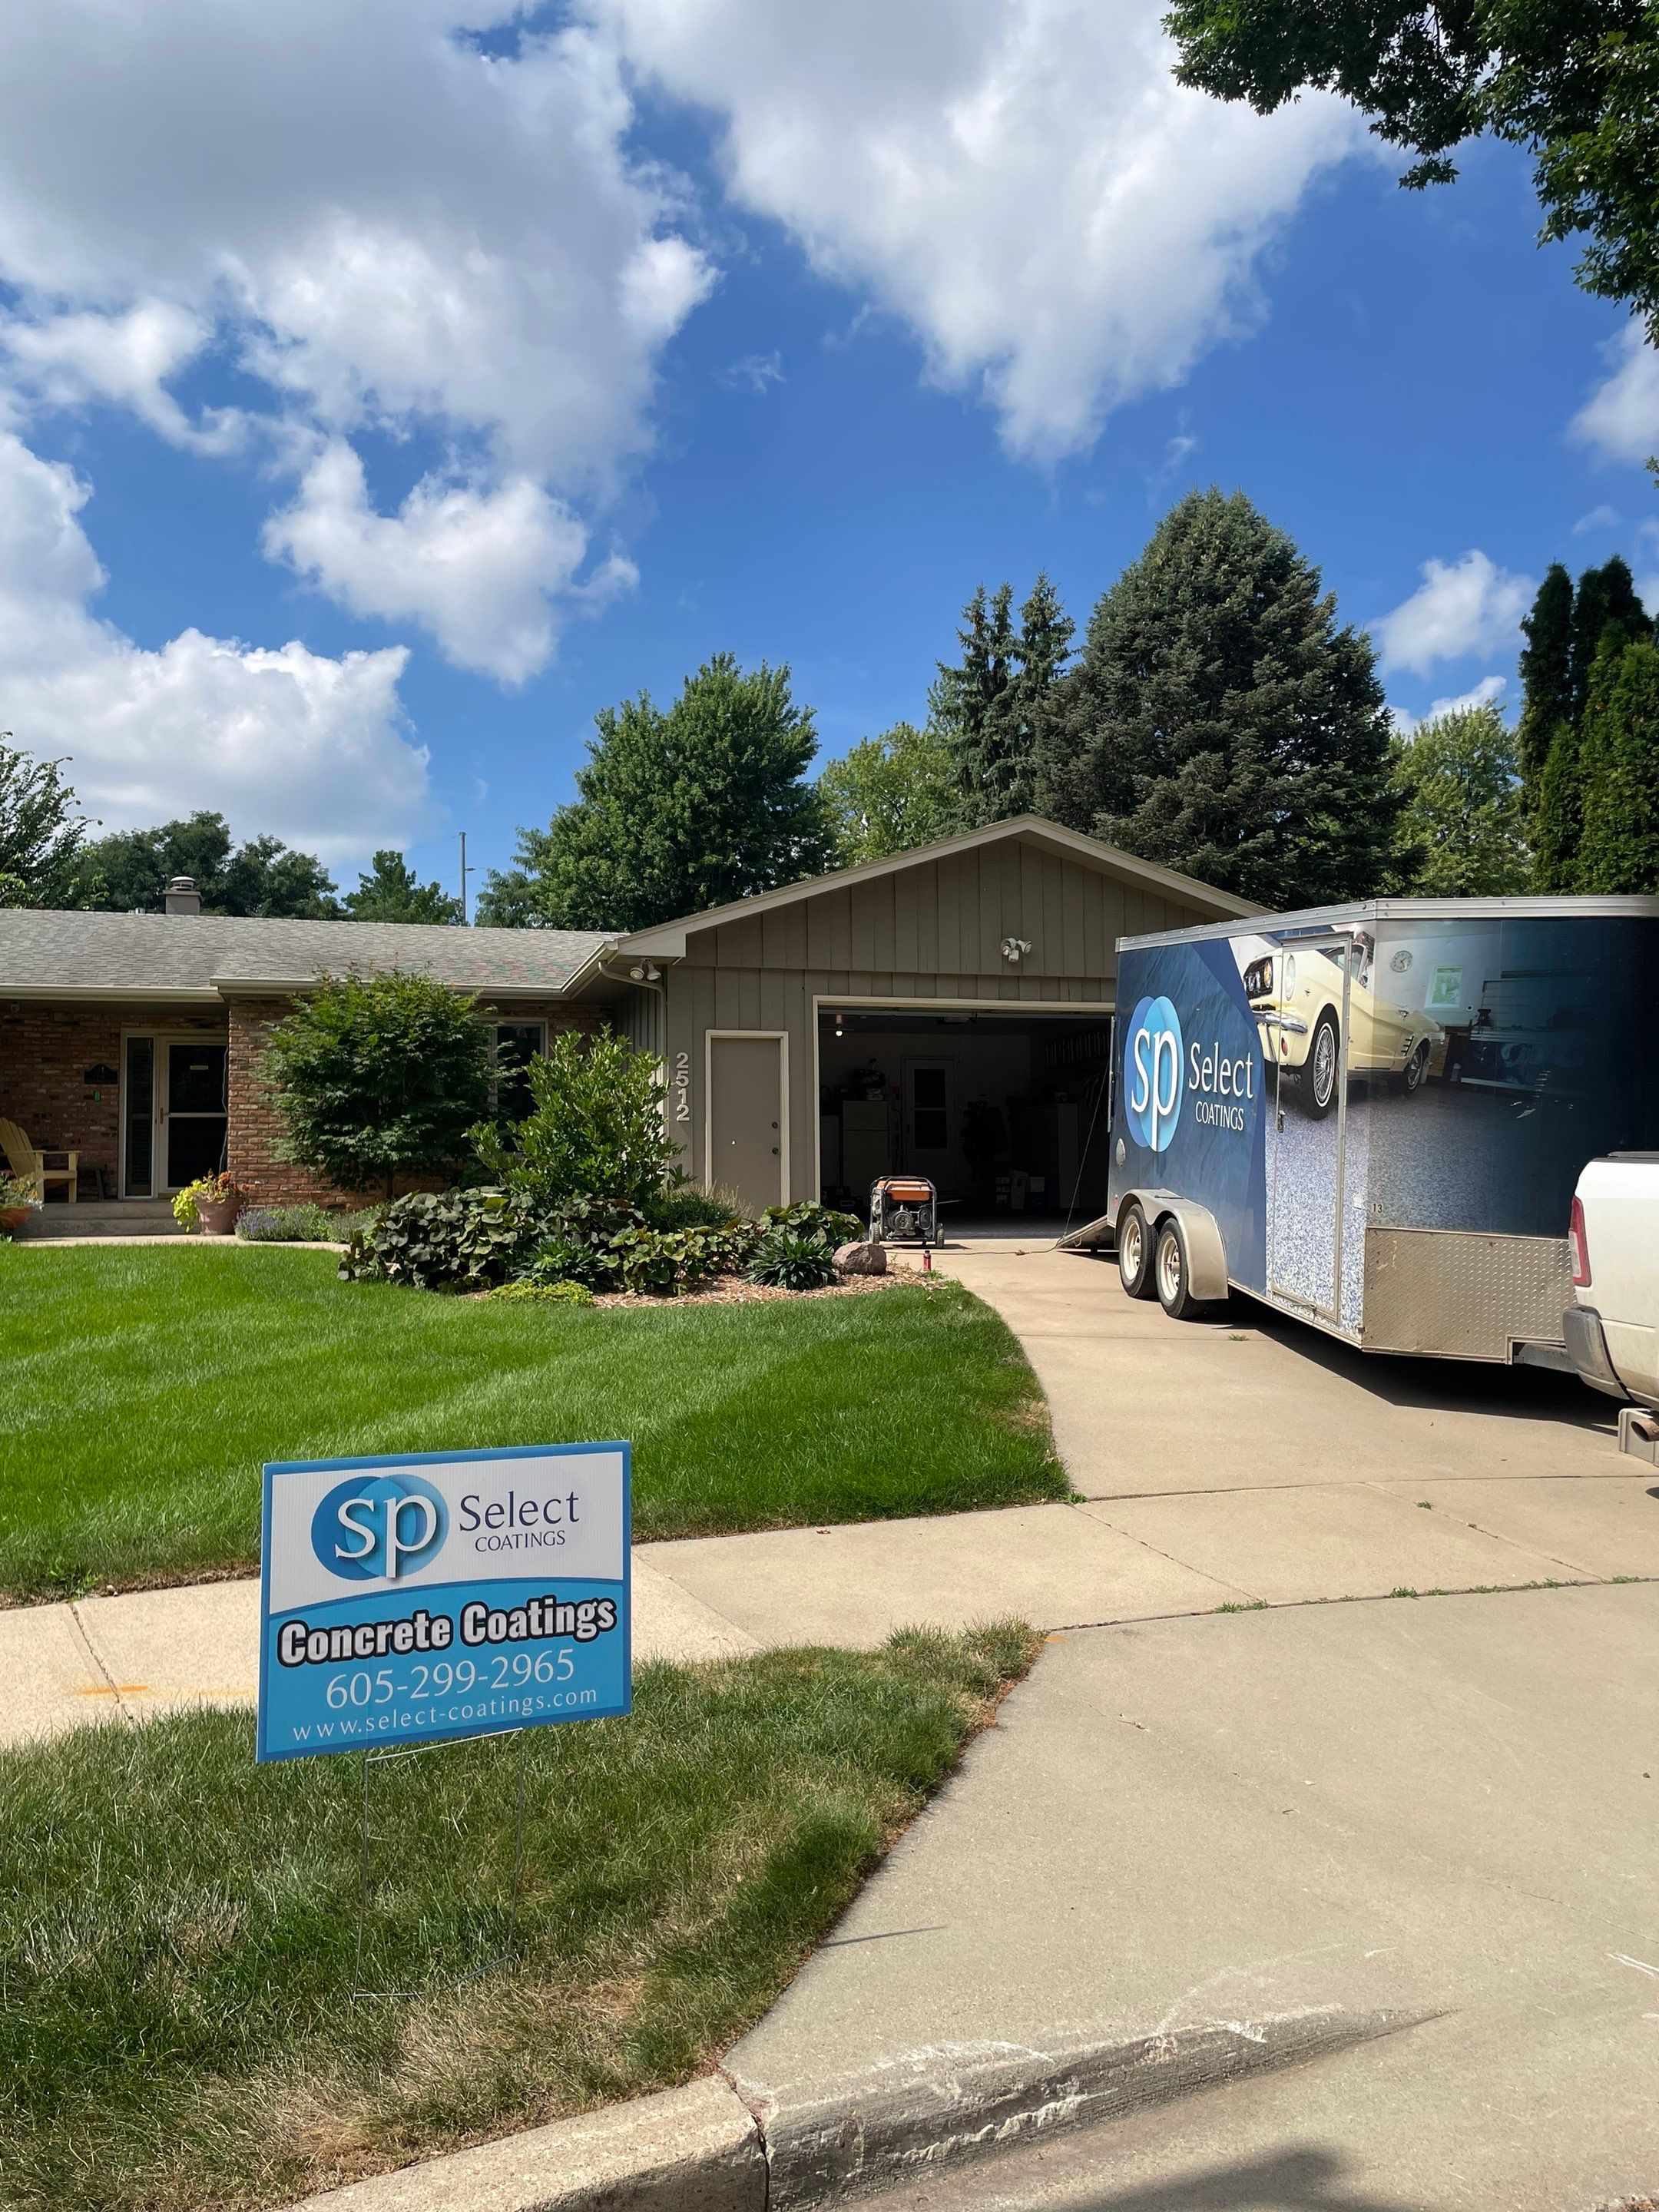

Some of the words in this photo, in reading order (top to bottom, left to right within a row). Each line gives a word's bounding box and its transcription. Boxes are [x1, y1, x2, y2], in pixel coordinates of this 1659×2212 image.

[675, 1051, 690, 1121] 2512
[1189, 1041, 1253, 1098] Select
[1195, 1101, 1244, 1131] COATINGS
[459, 1491, 580, 1532] Select
[475, 1530, 566, 1552] COATINGS
[277, 1608, 454, 1667] Concrete
[460, 1594, 618, 1647] Coatings
[326, 1648, 575, 1709] 605-299-2965
[293, 1688, 597, 1741] www.select-coatings.com
